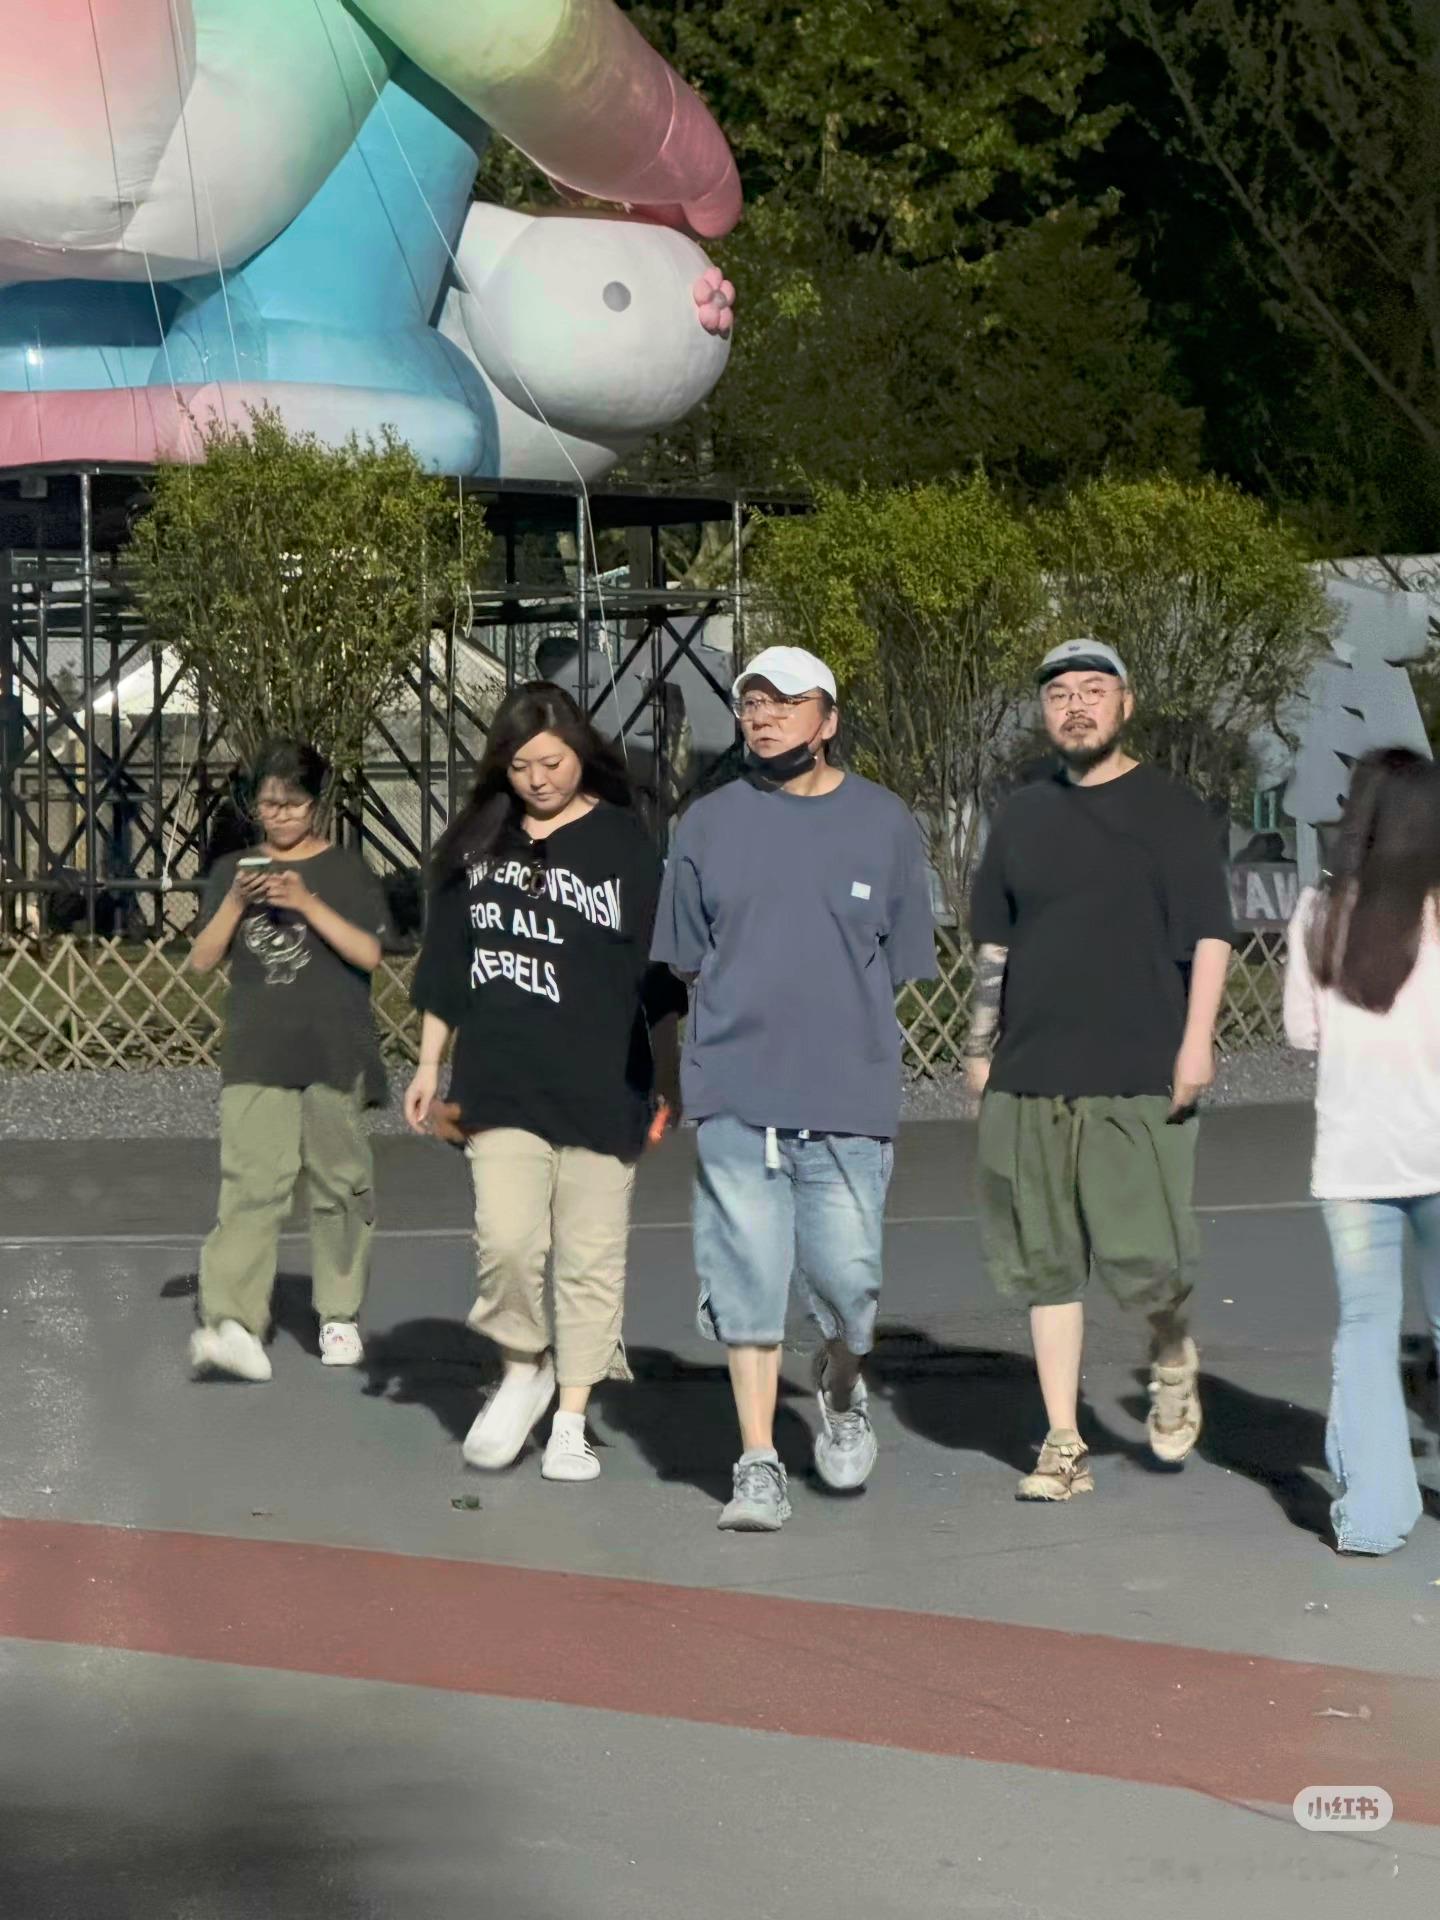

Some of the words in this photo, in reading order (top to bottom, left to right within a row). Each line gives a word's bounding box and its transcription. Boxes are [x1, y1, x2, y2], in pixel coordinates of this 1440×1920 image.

[470, 902, 504, 930] FOR
[512, 908, 564, 945] ALL
[470, 947, 560, 1003] REBELS
